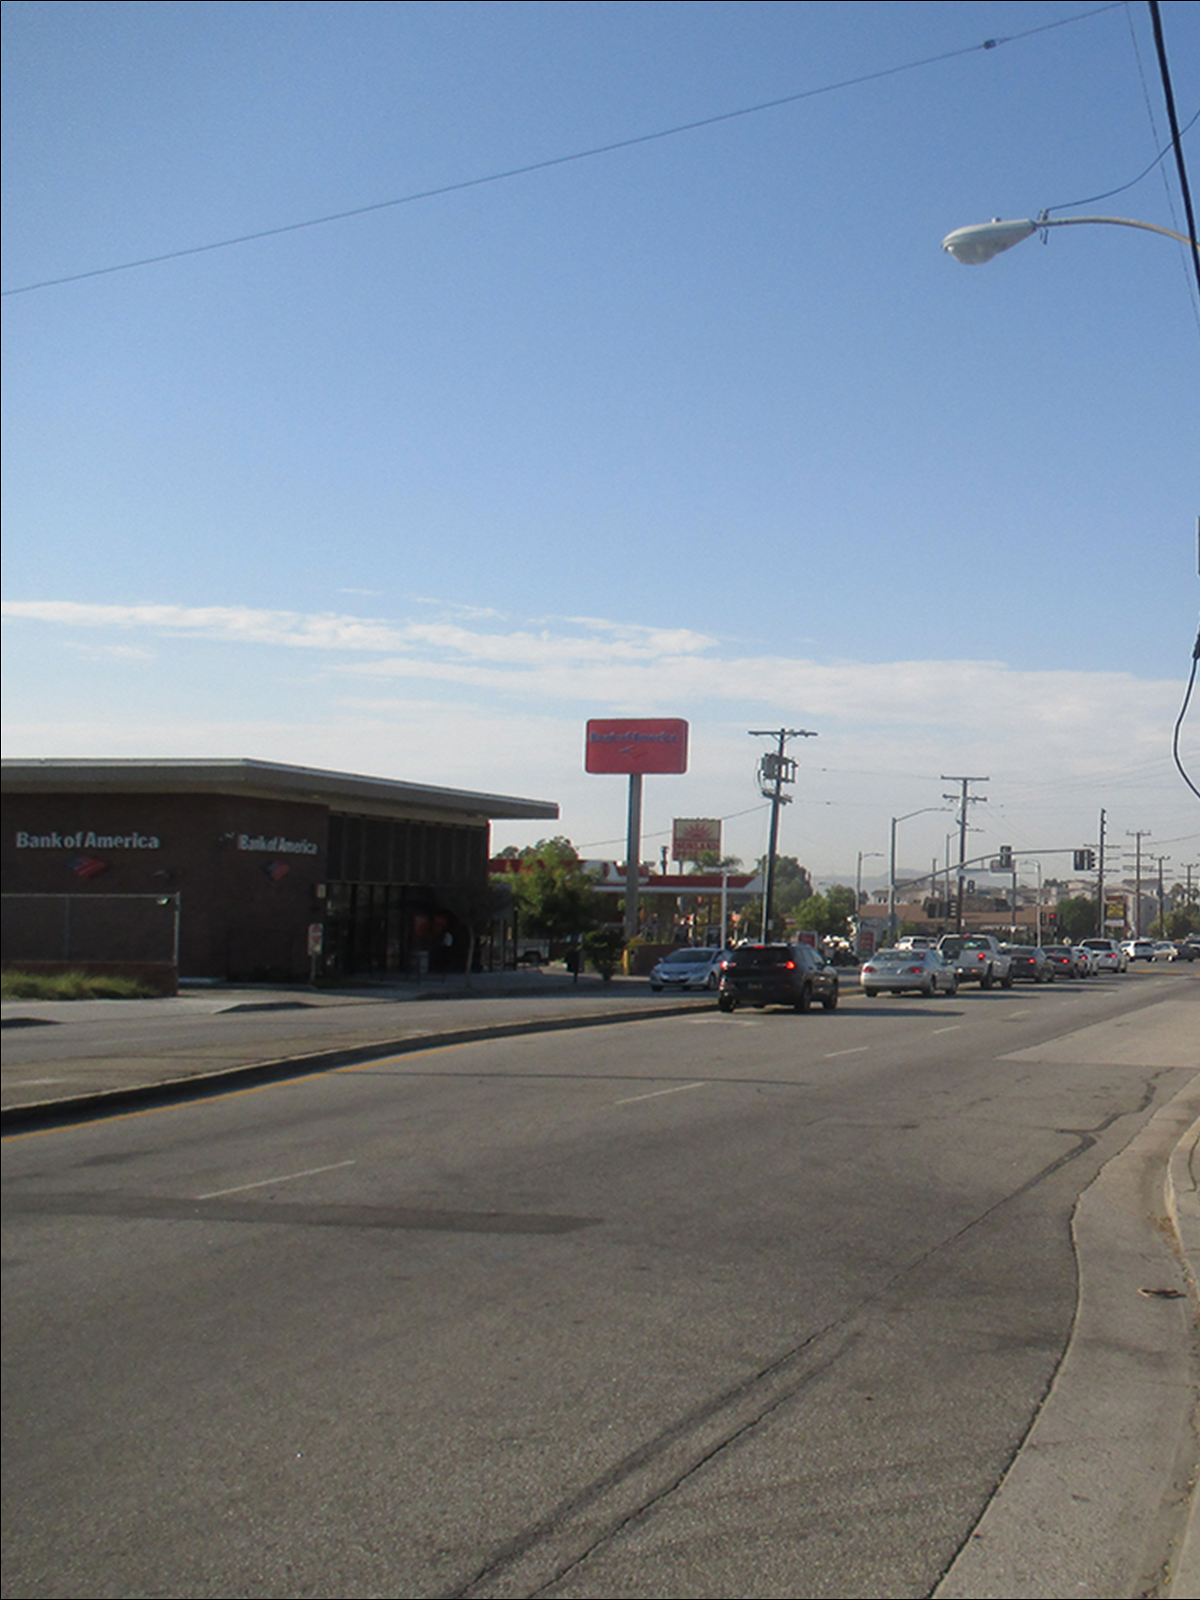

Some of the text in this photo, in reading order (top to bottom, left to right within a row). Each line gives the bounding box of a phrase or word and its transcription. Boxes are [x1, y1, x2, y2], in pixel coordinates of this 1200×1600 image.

[16, 831, 160, 848] Bank of America
[237, 834, 266, 850] Bank
[279, 837, 318, 854] America
